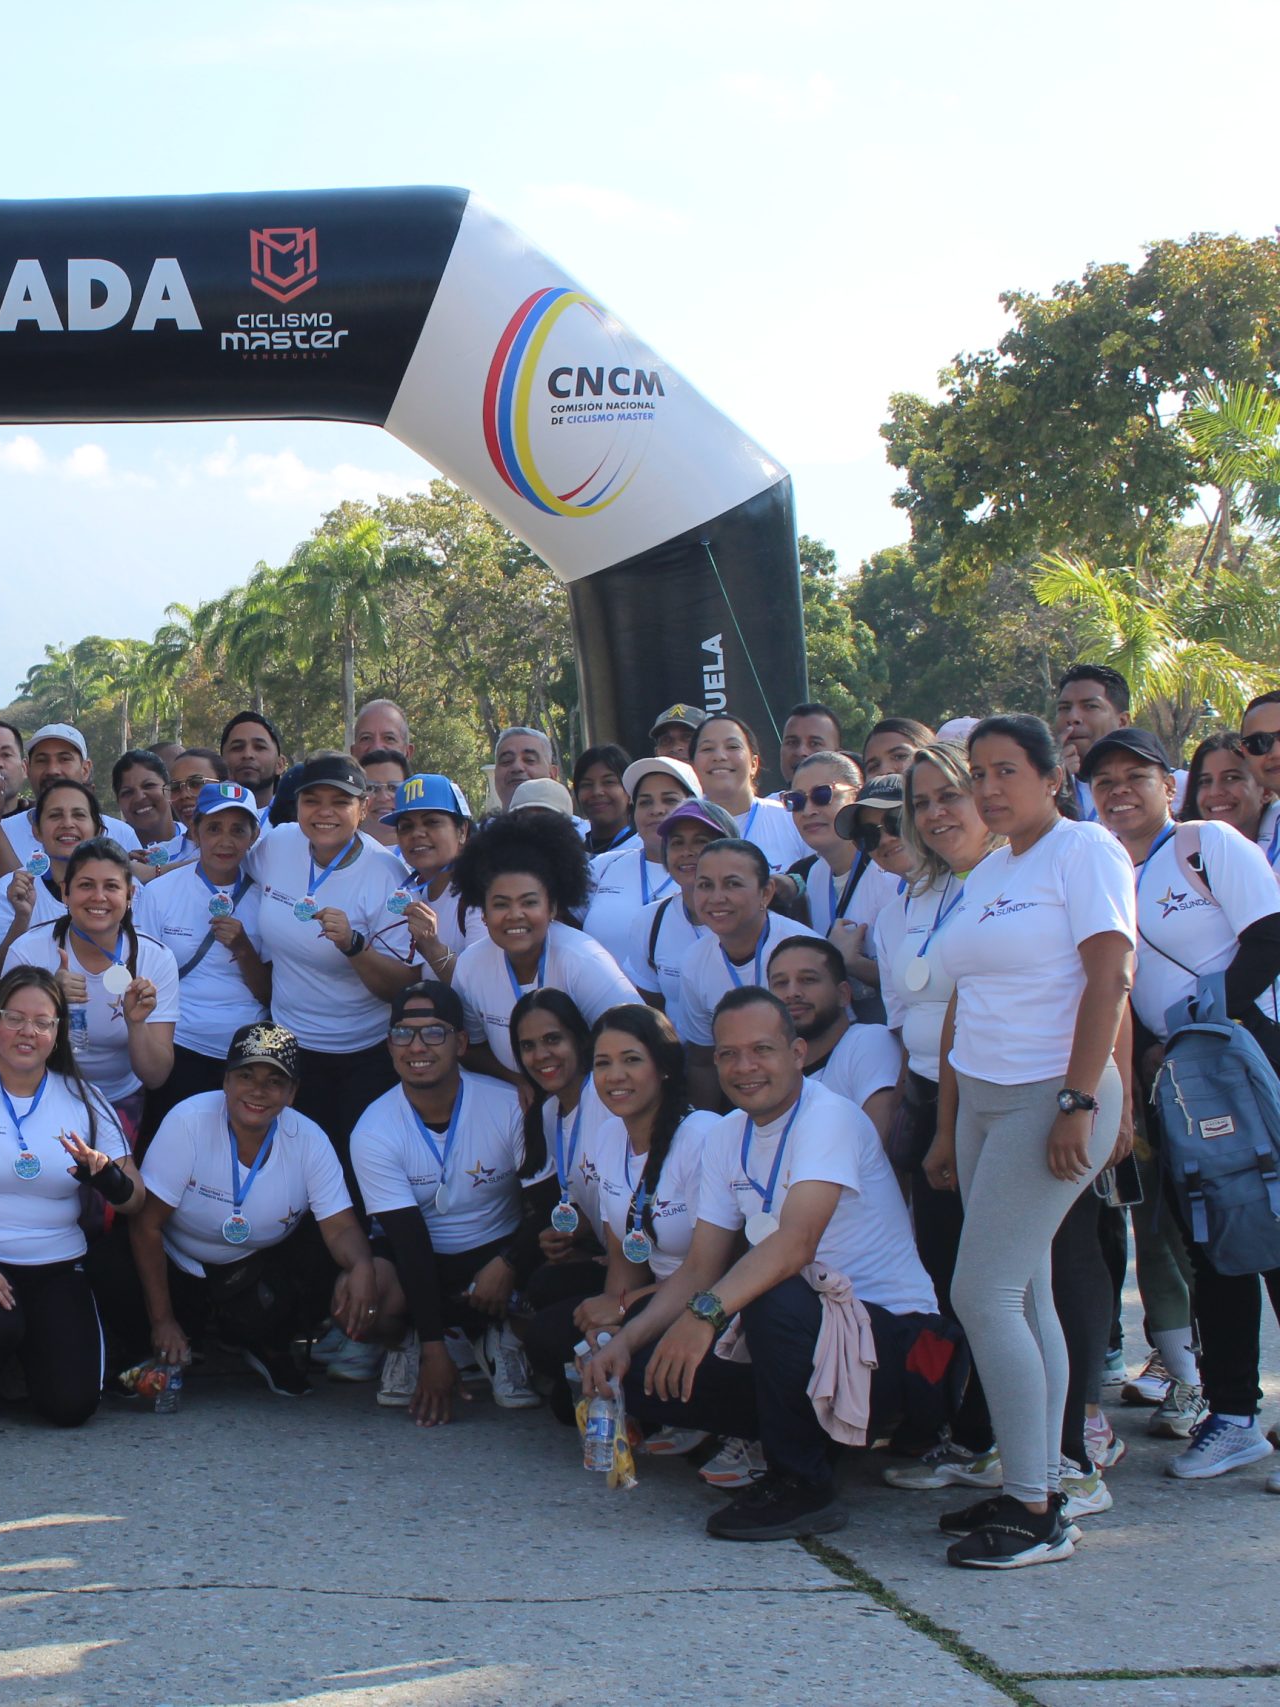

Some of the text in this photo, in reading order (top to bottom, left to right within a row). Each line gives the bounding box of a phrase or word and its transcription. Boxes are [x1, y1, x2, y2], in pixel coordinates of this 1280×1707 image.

[237, 312, 333, 328] CICLISMO
[547, 366, 665, 399] CNCM
[550, 401, 656, 414] COMISIÓN NACIONAL
[551, 412, 654, 425] DE CICLISMO MASTER
